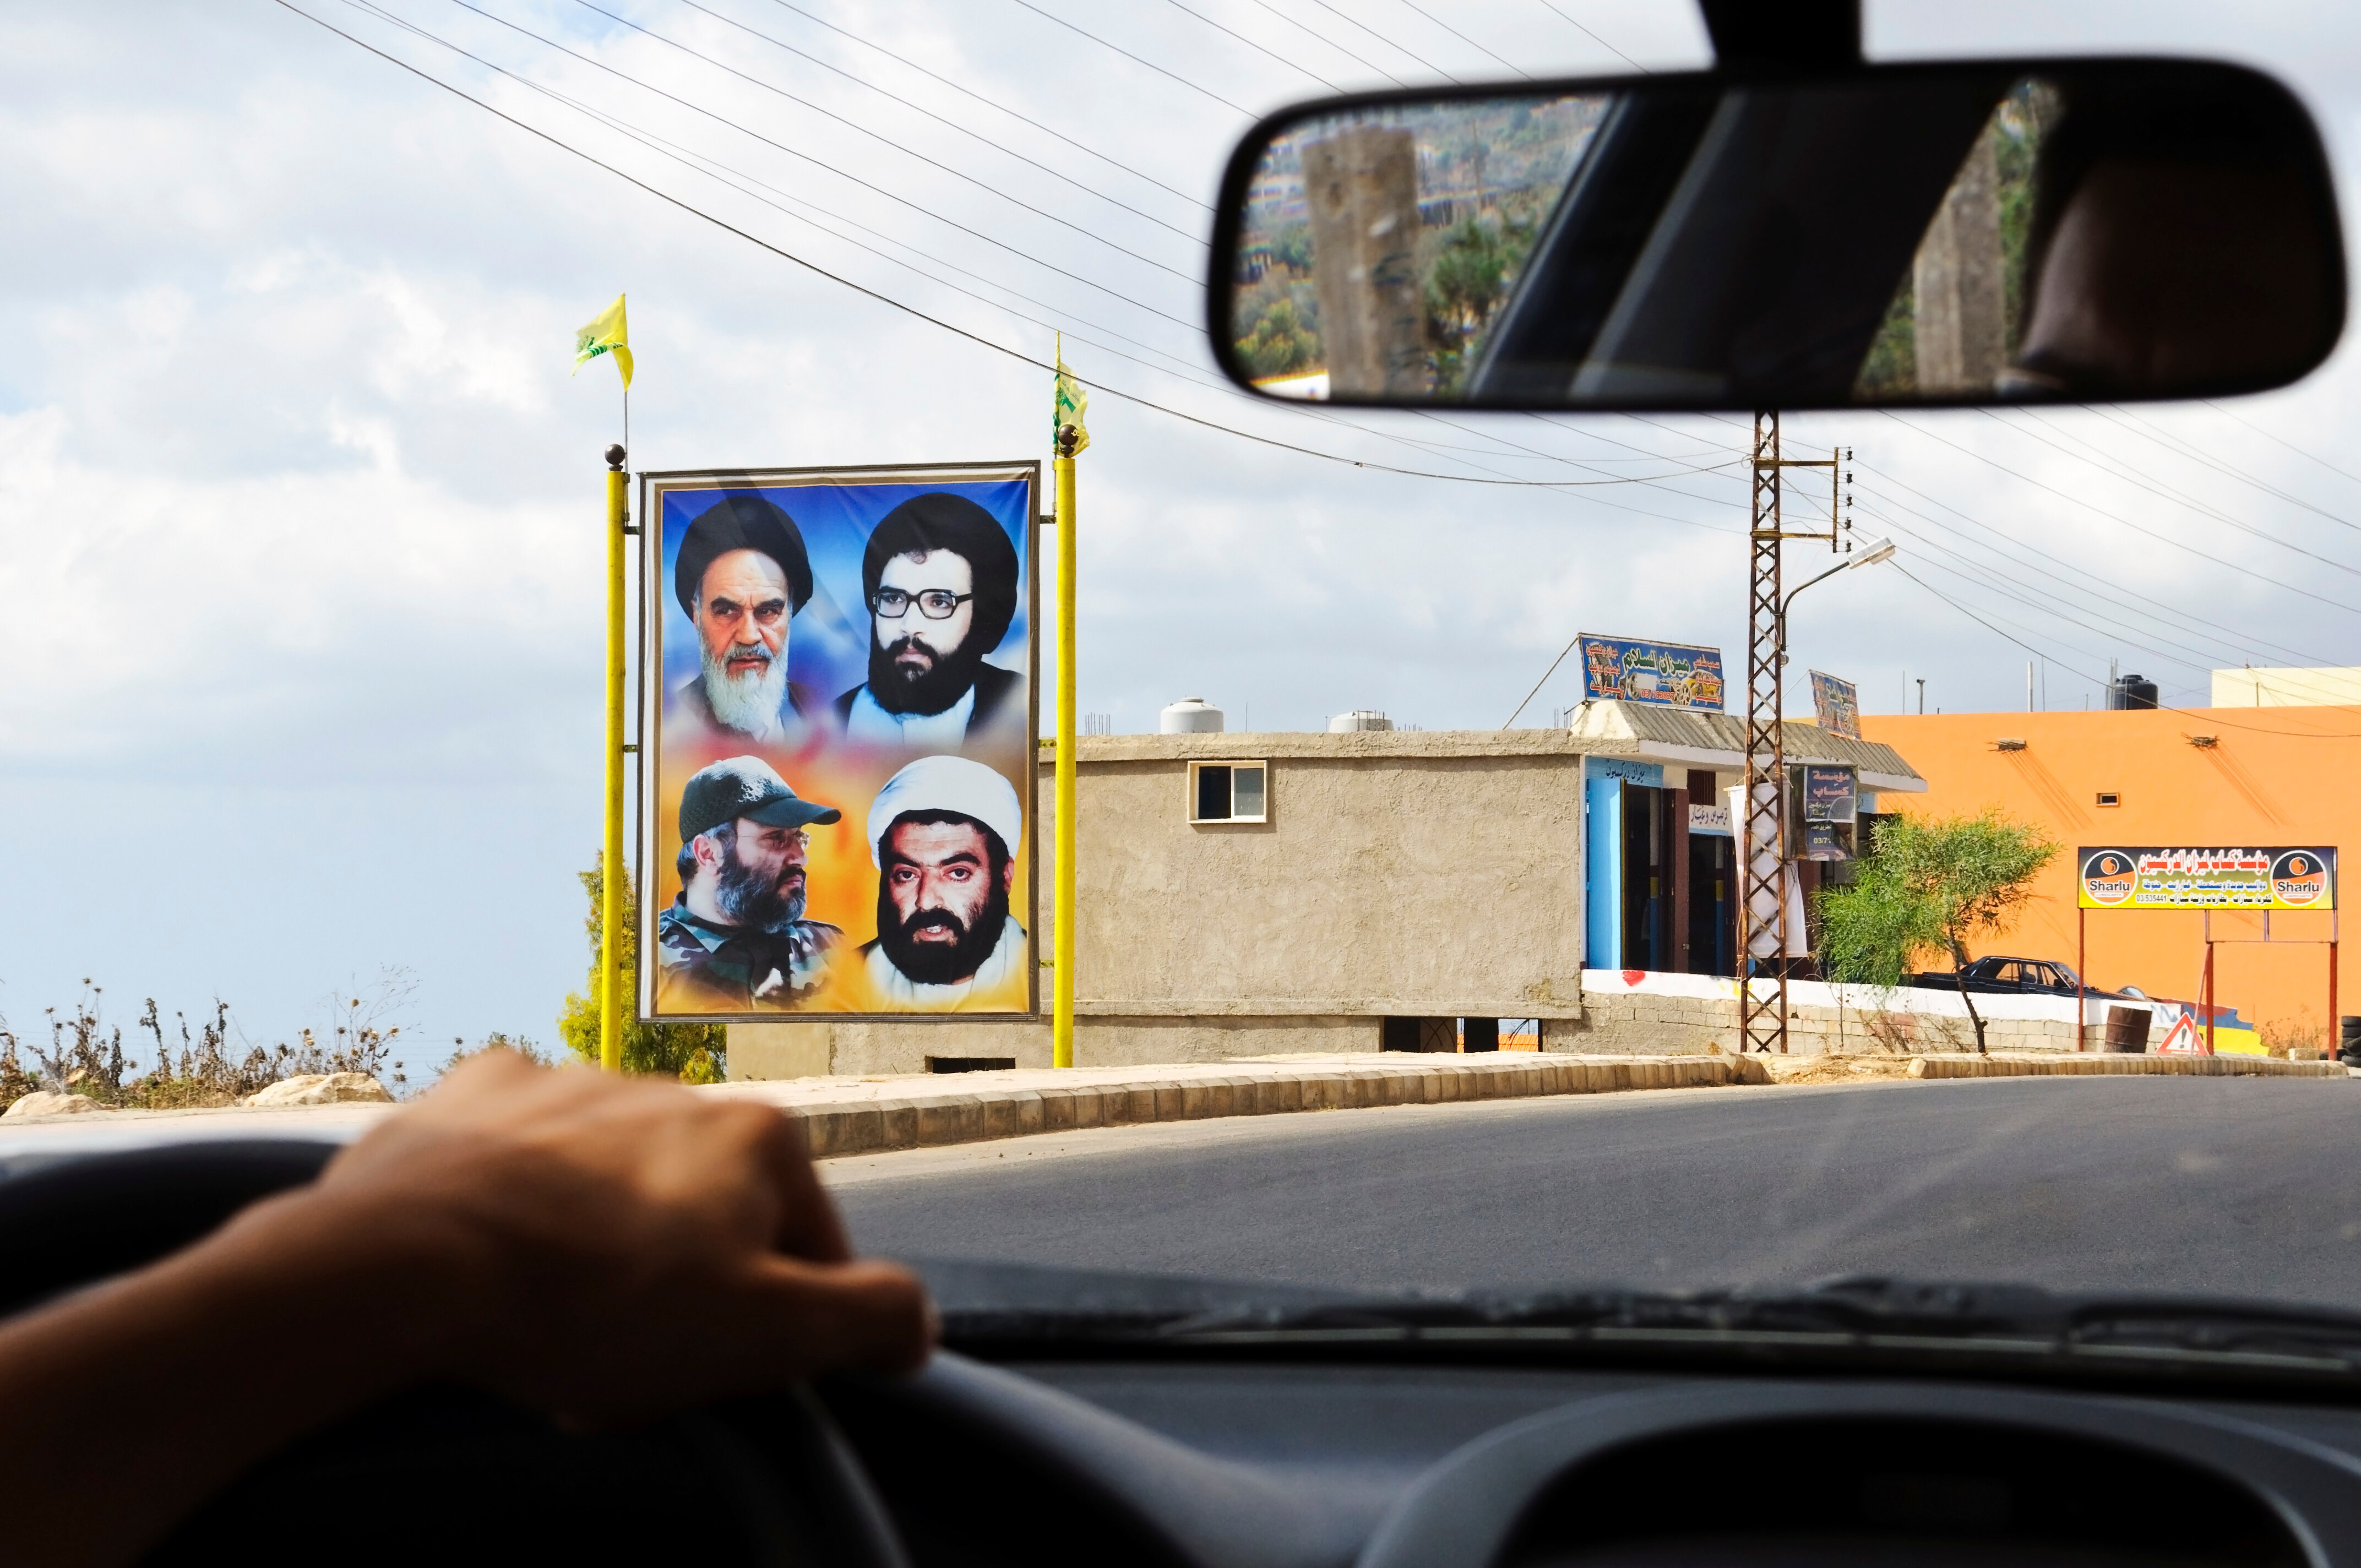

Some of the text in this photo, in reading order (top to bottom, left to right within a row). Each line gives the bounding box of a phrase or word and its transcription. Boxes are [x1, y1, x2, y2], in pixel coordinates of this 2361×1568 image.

[1622, 647, 1658, 675] السلام
[1658, 652, 1690, 678] ميزان
[1812, 770, 1850, 783] مؤسسة
[1812, 786, 1849, 798] كساب
[2211, 849, 2237, 874] كساب
[2237, 850, 2269, 874] مؤسسة
[2090, 880, 2130, 891] Sharlu
[2226, 880, 2245, 891] جديدة
[2246, 880, 2267, 891] دواليب
[2277, 881, 2319, 892] Sharlu
[2169, 894, 2189, 905] سيارات
[2206, 894, 2227, 905] بطاريات
[2233, 894, 2253, 905] سيارات
